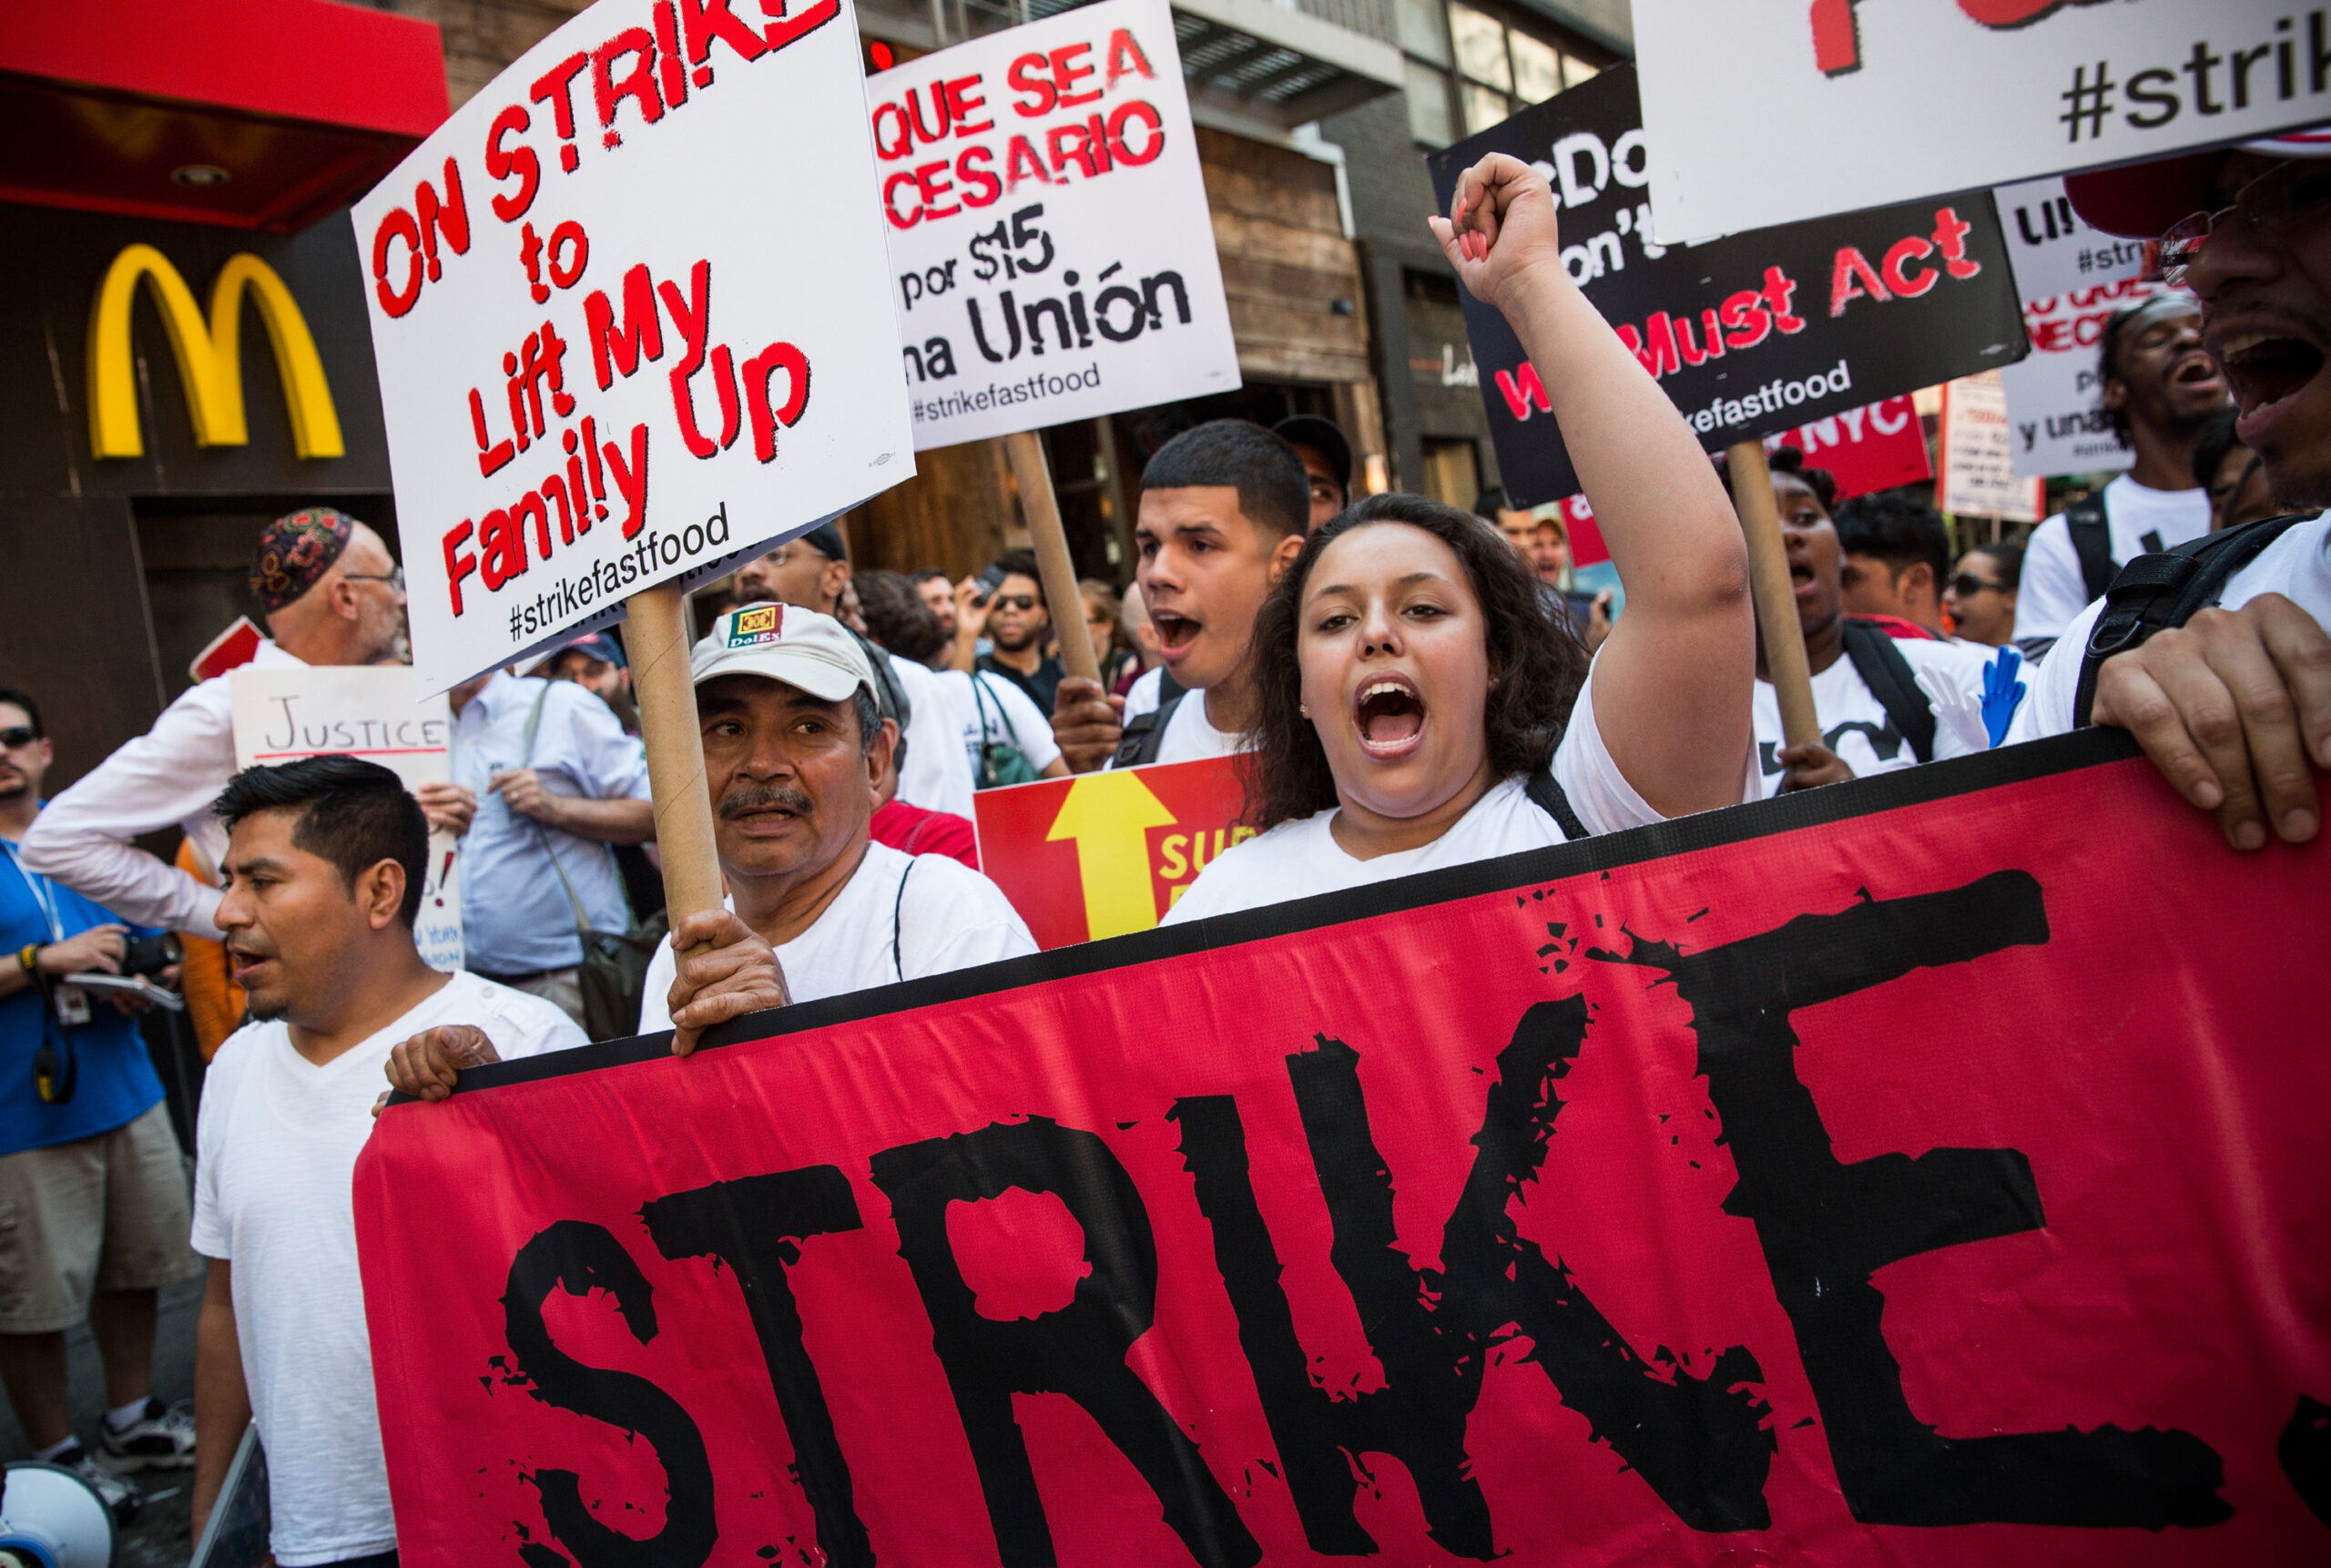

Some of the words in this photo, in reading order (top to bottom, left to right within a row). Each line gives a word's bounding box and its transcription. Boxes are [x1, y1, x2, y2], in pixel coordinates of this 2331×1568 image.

[871, 73, 994, 161] QUE
[1007, 27, 1160, 117] SEA
[882, 100, 1166, 230] CESARIO
[372, 156, 470, 318] ON
[520, 220, 589, 304] to
[900, 259, 959, 311] por
[969, 203, 1055, 284] $15
[1614, 265, 1807, 381] Must
[1828, 207, 1981, 318] Act
[468, 320, 576, 478] Lift
[583, 259, 711, 392] My
[966, 261, 1192, 364] Unión
[913, 361, 1101, 423] #strikefastfood
[442, 415, 649, 617] Family
[669, 341, 811, 464] Up
[509, 501, 730, 642] #strikefastfood
[265, 694, 447, 750] JUSTICE
[478, 867, 2331, 1568] STRIKE
